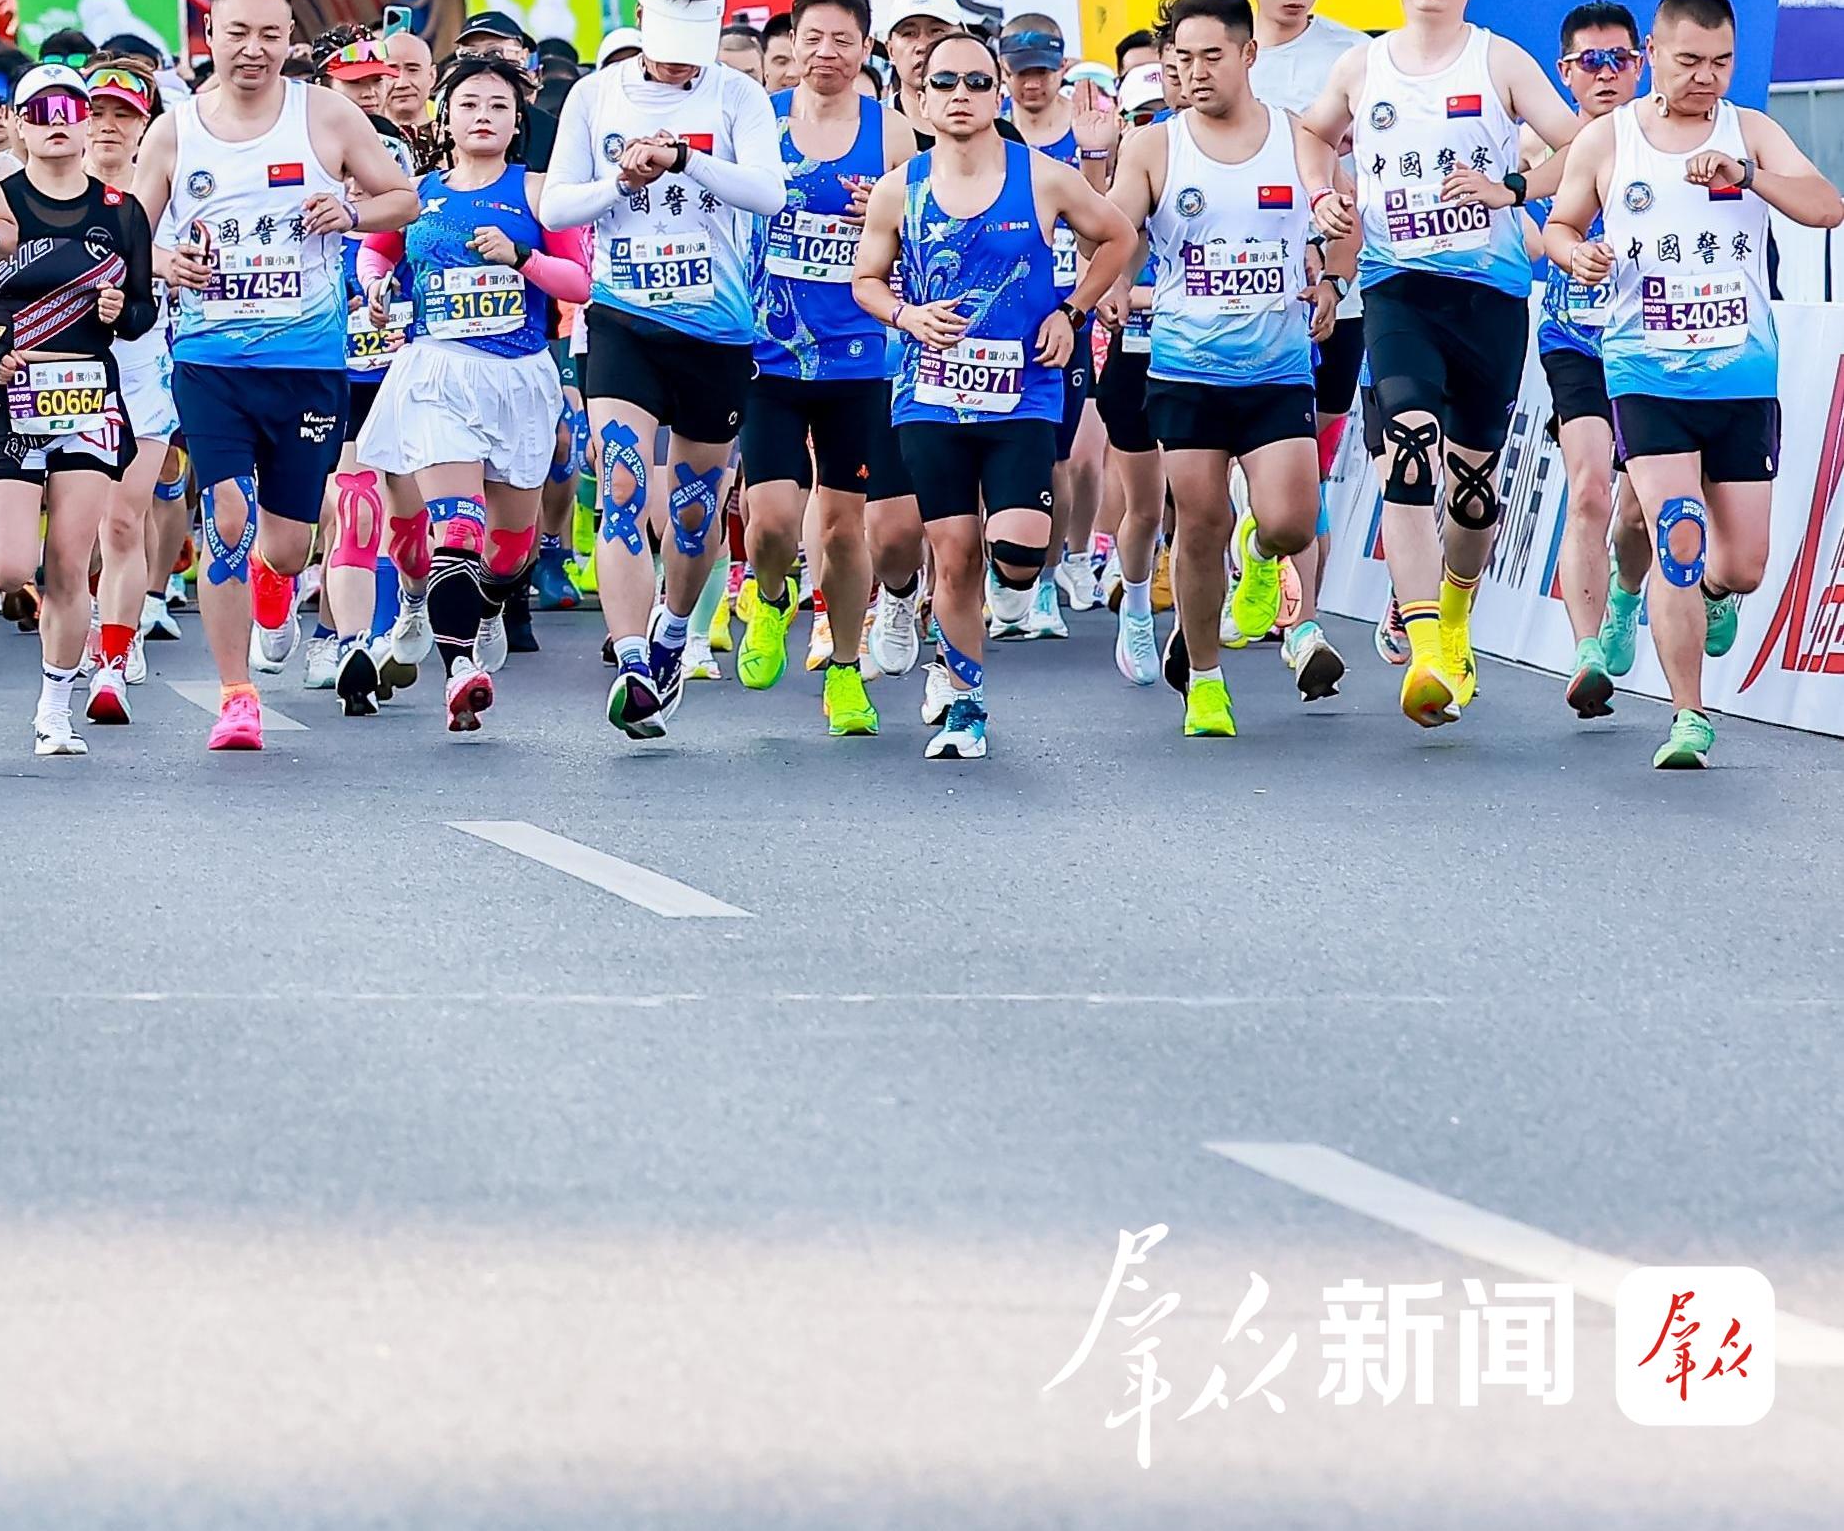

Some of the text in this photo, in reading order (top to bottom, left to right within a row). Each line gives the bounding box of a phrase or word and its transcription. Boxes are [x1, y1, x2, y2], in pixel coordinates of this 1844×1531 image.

[1392, 193, 1404, 209] D
[781, 211, 793, 226] D
[1414, 203, 1488, 235] 51006
[617, 243, 629, 258] D
[1191, 248, 1204, 264] D
[1627, 232, 1753, 270] 中國警察
[225, 271, 299, 298] 57454
[431, 274, 442, 290] D
[636, 261, 710, 289] 13813
[1210, 266, 1281, 294] 54209
[1649, 280, 1662, 297] D
[450, 292, 524, 319] 31672
[1671, 296, 1747, 330] 54053
[14, 372, 27, 386] D
[942, 364, 1016, 395] 50971
[36, 388, 103, 415] 60664
